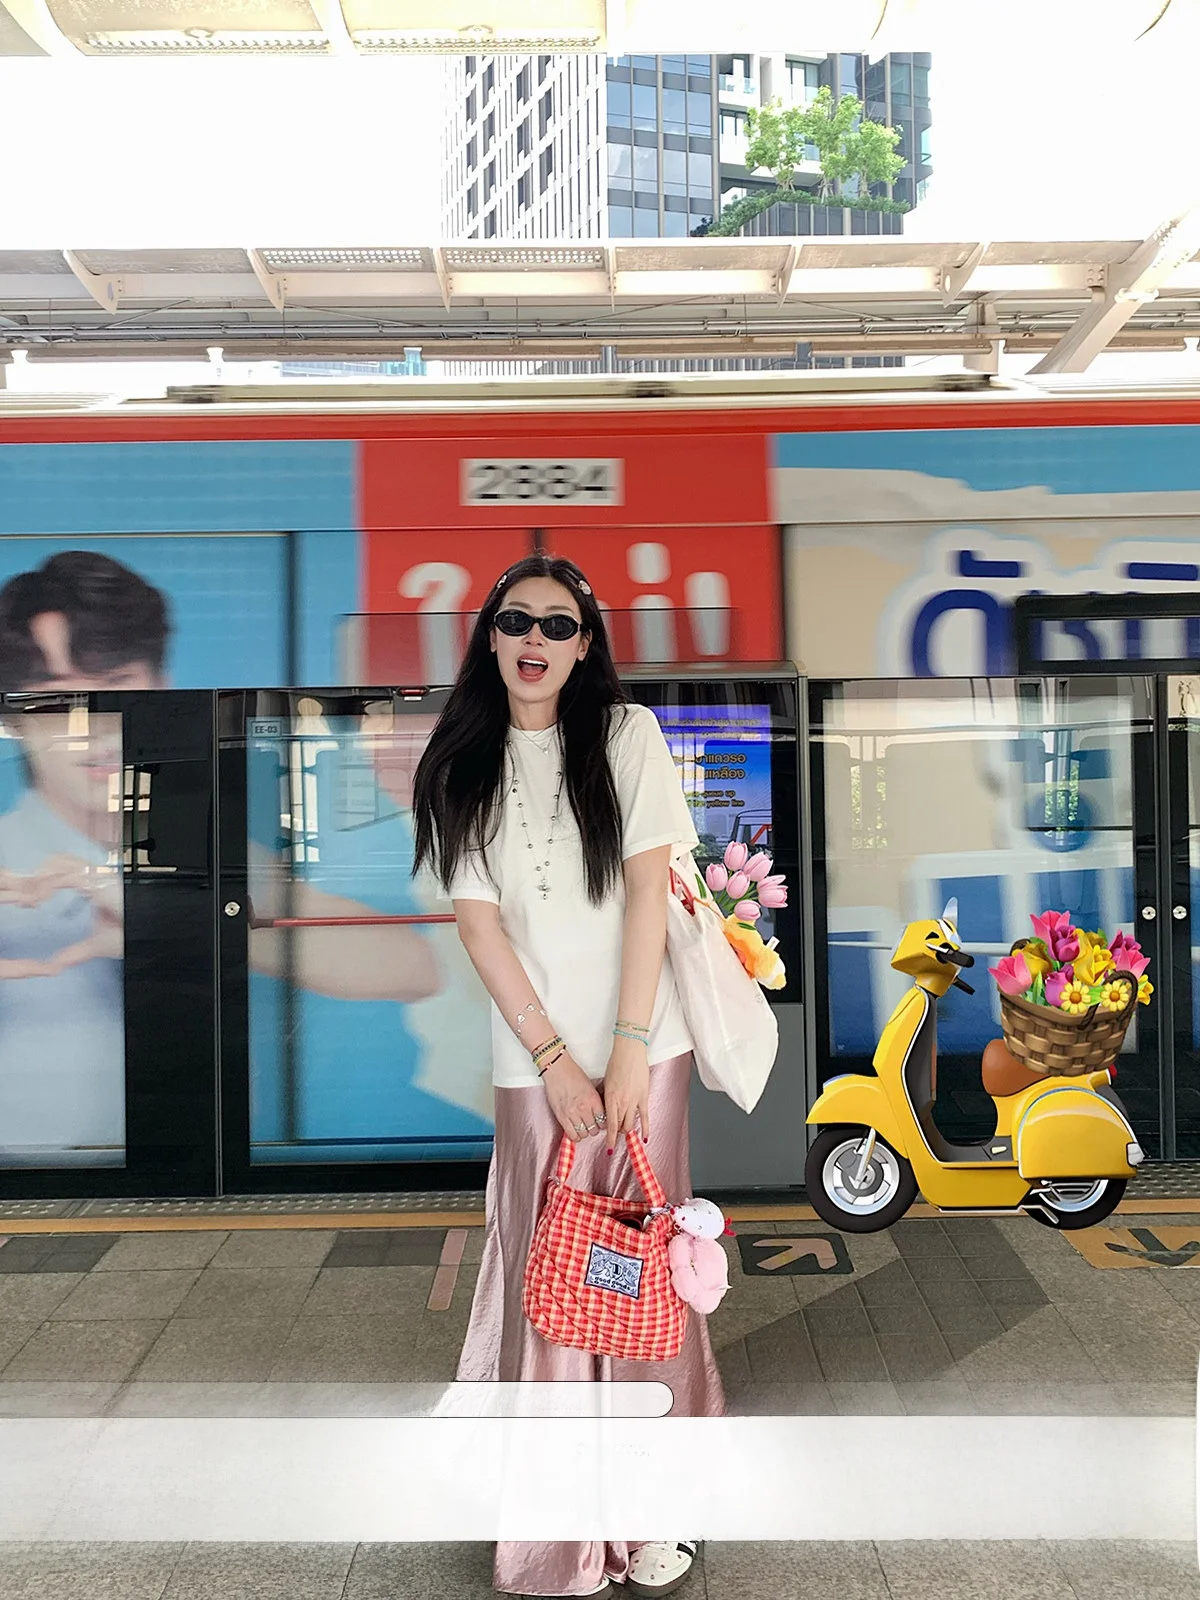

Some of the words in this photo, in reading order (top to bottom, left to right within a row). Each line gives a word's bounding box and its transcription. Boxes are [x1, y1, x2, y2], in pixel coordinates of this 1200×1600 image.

[468, 465, 615, 499] 2884
[254, 725, 278, 734] EE-03
[725, 790, 736, 798] up
[706, 800, 730, 808] yellow
[731, 799, 745, 807] line
